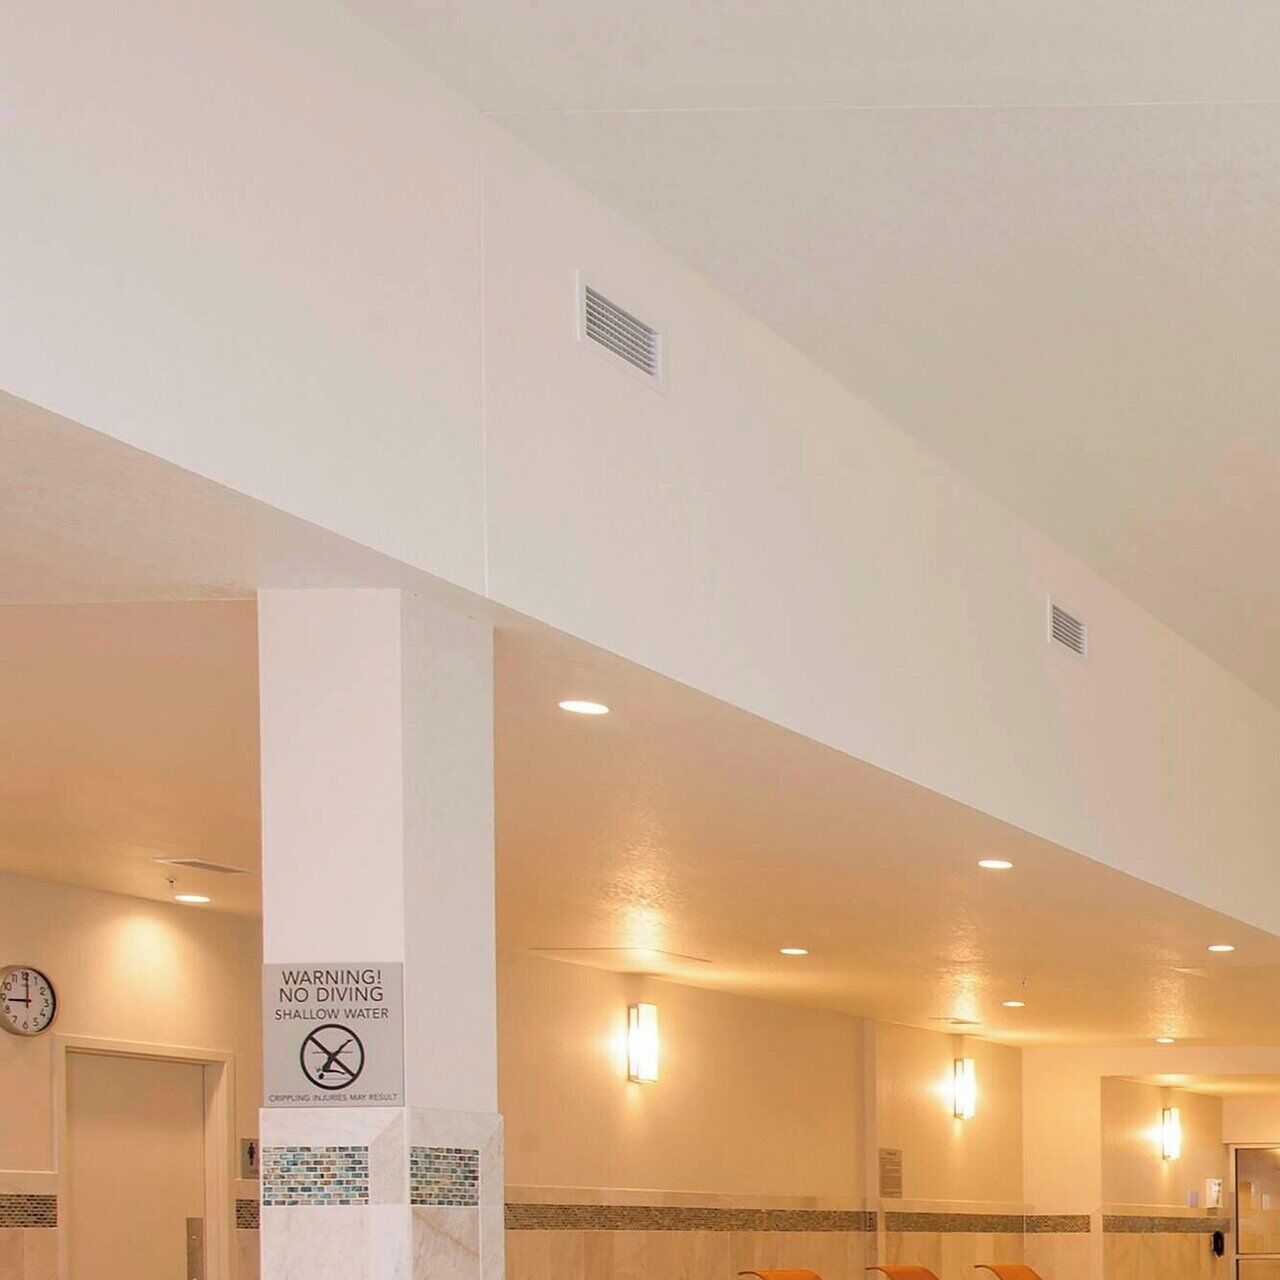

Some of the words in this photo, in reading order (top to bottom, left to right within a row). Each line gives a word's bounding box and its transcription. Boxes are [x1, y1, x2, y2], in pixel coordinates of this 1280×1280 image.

[282, 969, 382, 985] WARNING!
[39, 987, 45, 996] 2
[279, 987, 309, 1003] NO
[316, 986, 384, 1002] DIVING
[43, 998, 49, 1008] 3
[274, 1008, 340, 1021] SHALLOW
[344, 1007, 389, 1019] WATER
[12, 1015, 18, 1024] 7
[33, 1017, 39, 1027] 5
[22, 1021, 29, 1030] 6
[268, 1094, 310, 1103] CRIPPLING
[312, 1094, 347, 1102] INJURIES
[368, 1093, 398, 1101] RESULT
